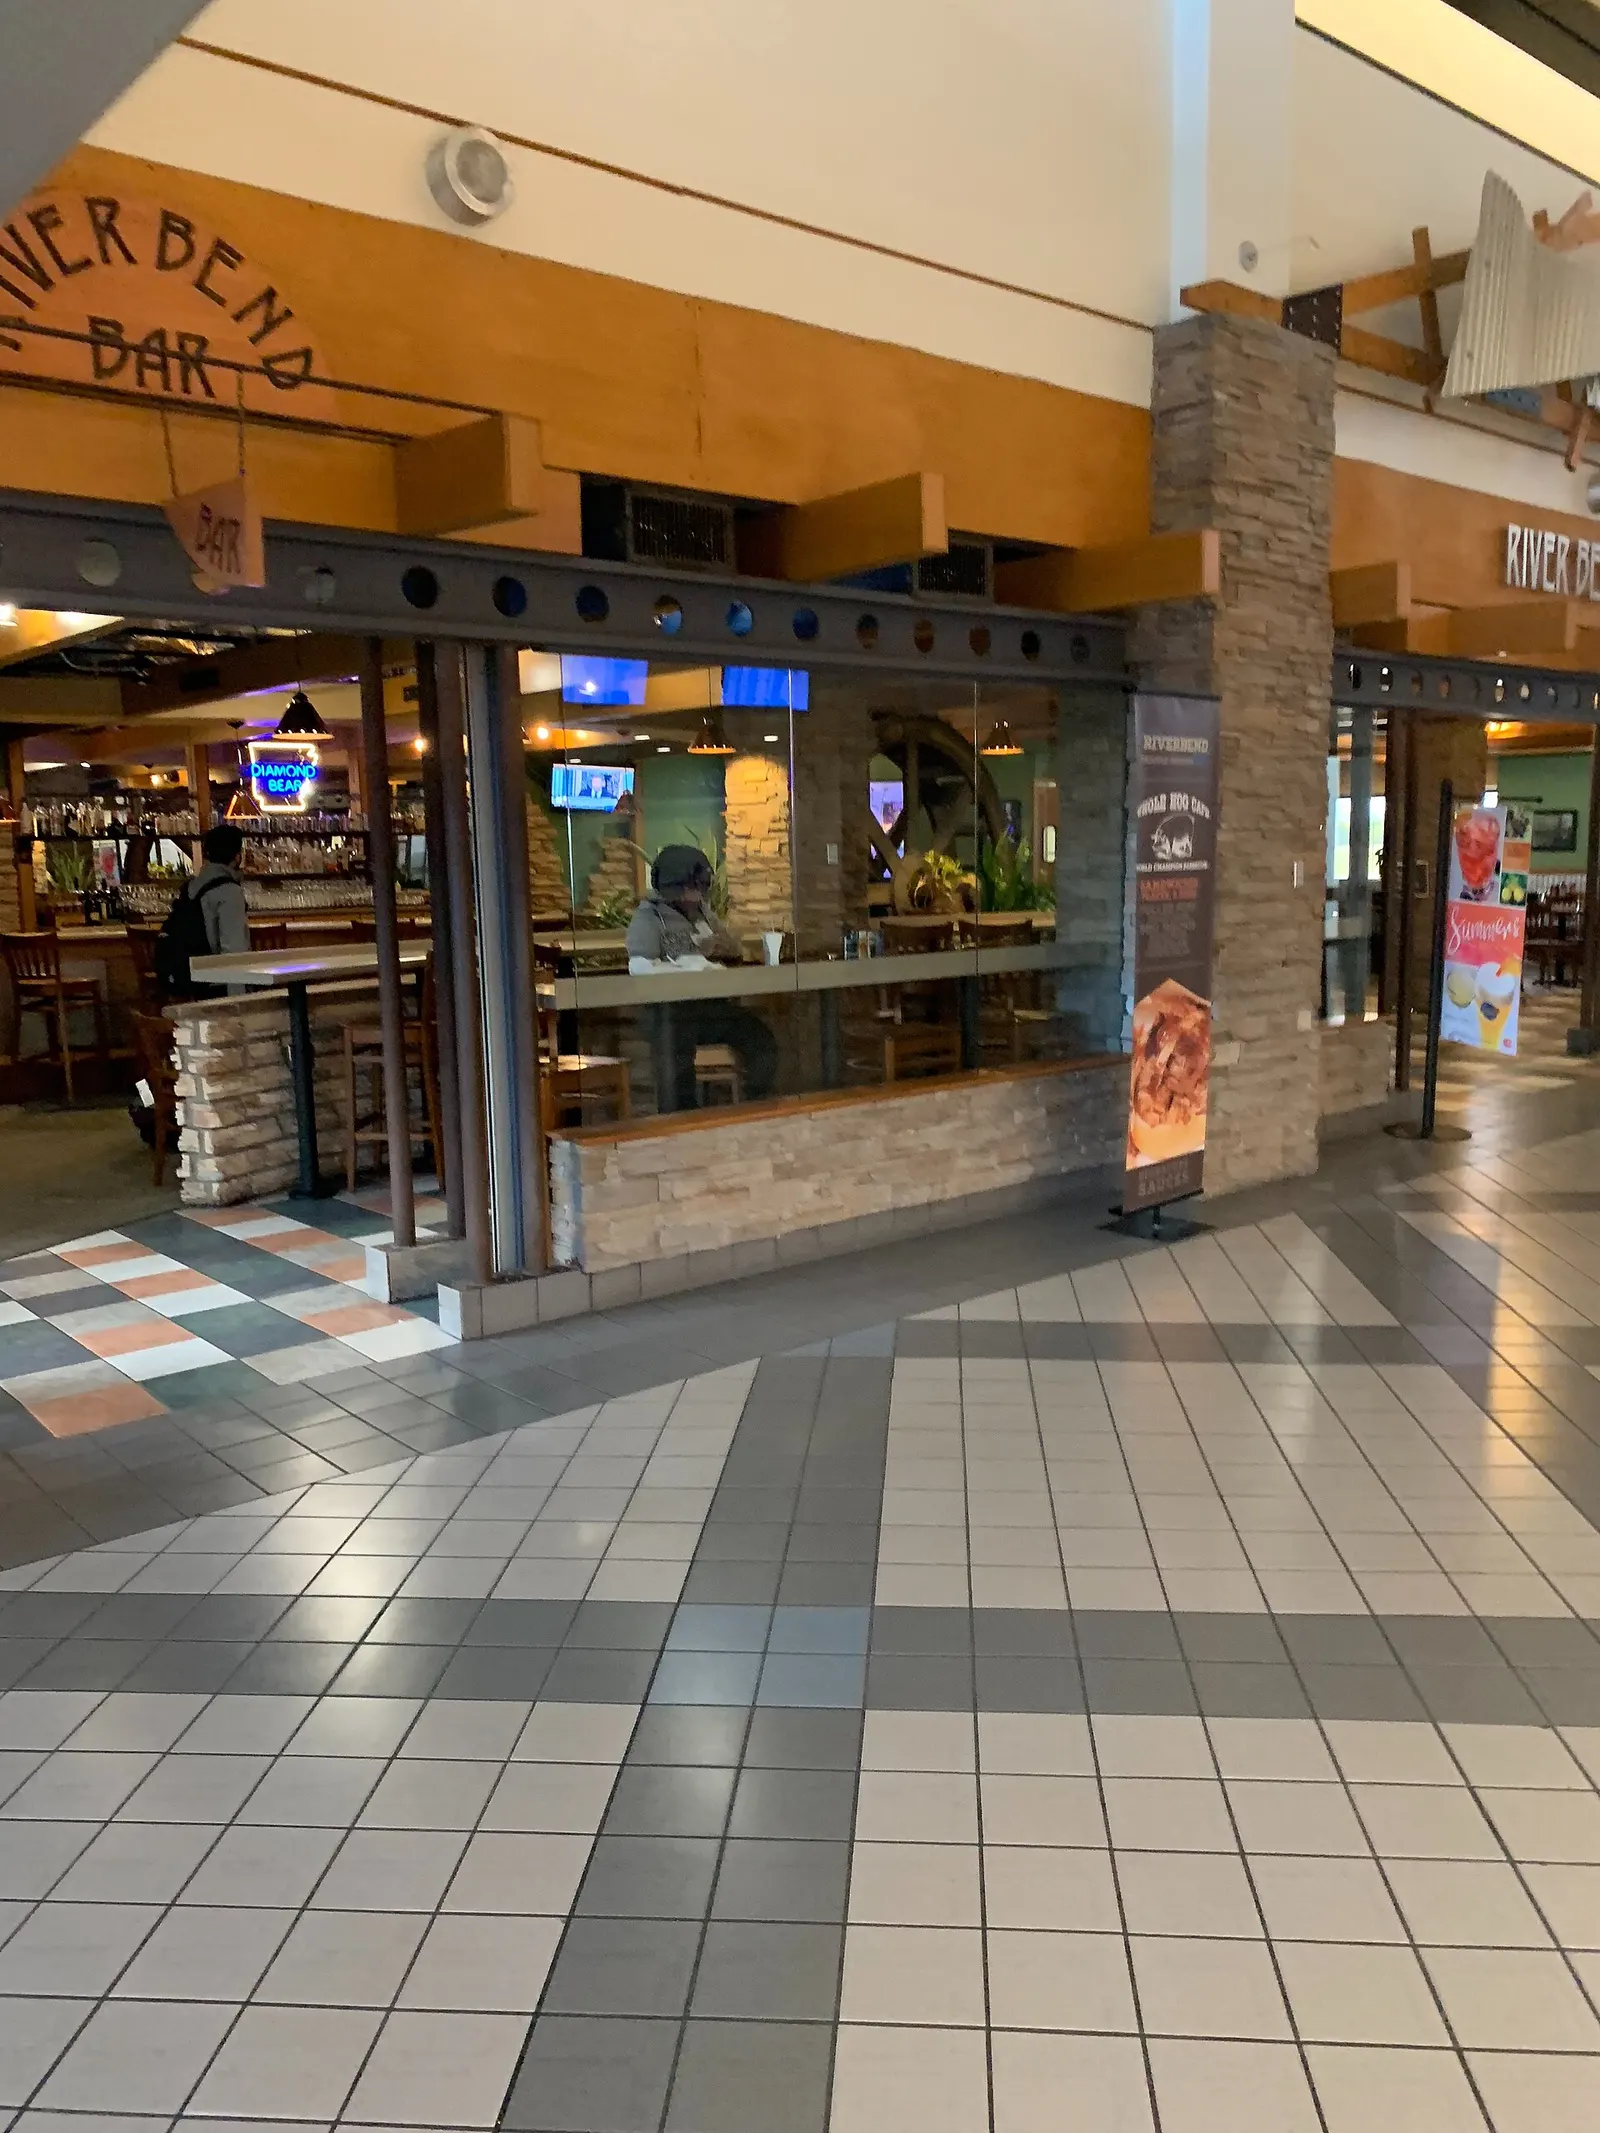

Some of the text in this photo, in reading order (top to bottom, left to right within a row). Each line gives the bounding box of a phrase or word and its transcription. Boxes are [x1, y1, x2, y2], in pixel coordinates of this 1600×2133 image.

[155, 207, 313, 391] BEND
[87, 314, 216, 399] BAR
[195, 502, 241, 574] BAR
[1506, 522, 1571, 596] RIVER
[1143, 734, 1209, 754] RIVERBEND
[251, 764, 316, 778] DIAMOND
[268, 778, 303, 792] BEAR
[1169, 791, 1189, 813] HOG
